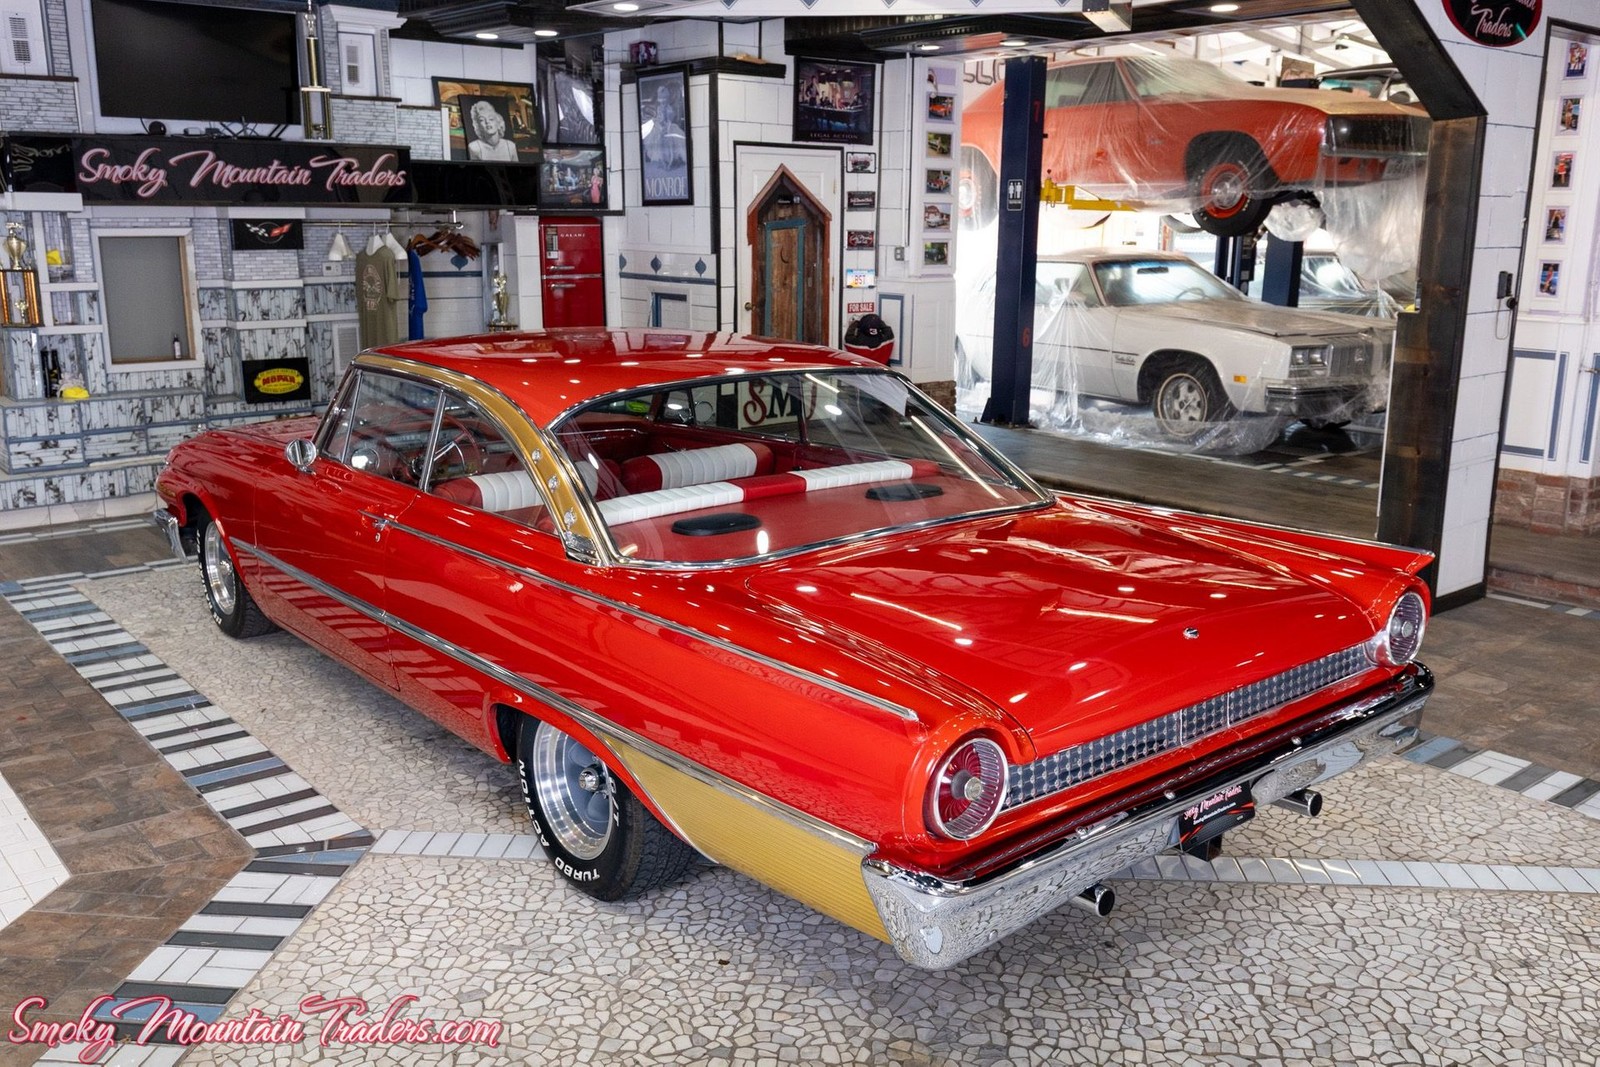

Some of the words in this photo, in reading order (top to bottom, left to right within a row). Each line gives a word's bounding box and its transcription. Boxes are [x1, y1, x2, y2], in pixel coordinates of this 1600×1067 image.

[1471, 4, 1514, 38] Traders
[79, 147, 168, 197] Smoky
[169, 150, 311, 188] Mountain
[310, 153, 407, 191] Traders
[645, 176, 688, 198] MONROE
[848, 303, 860, 313] FOR
[860, 302, 874, 312] SALE
[869, 328, 878, 336] 3
[262, 374, 296, 387] MOPAR
[518, 758, 550, 848] ACTION
[554, 856, 601, 882] TURBO
